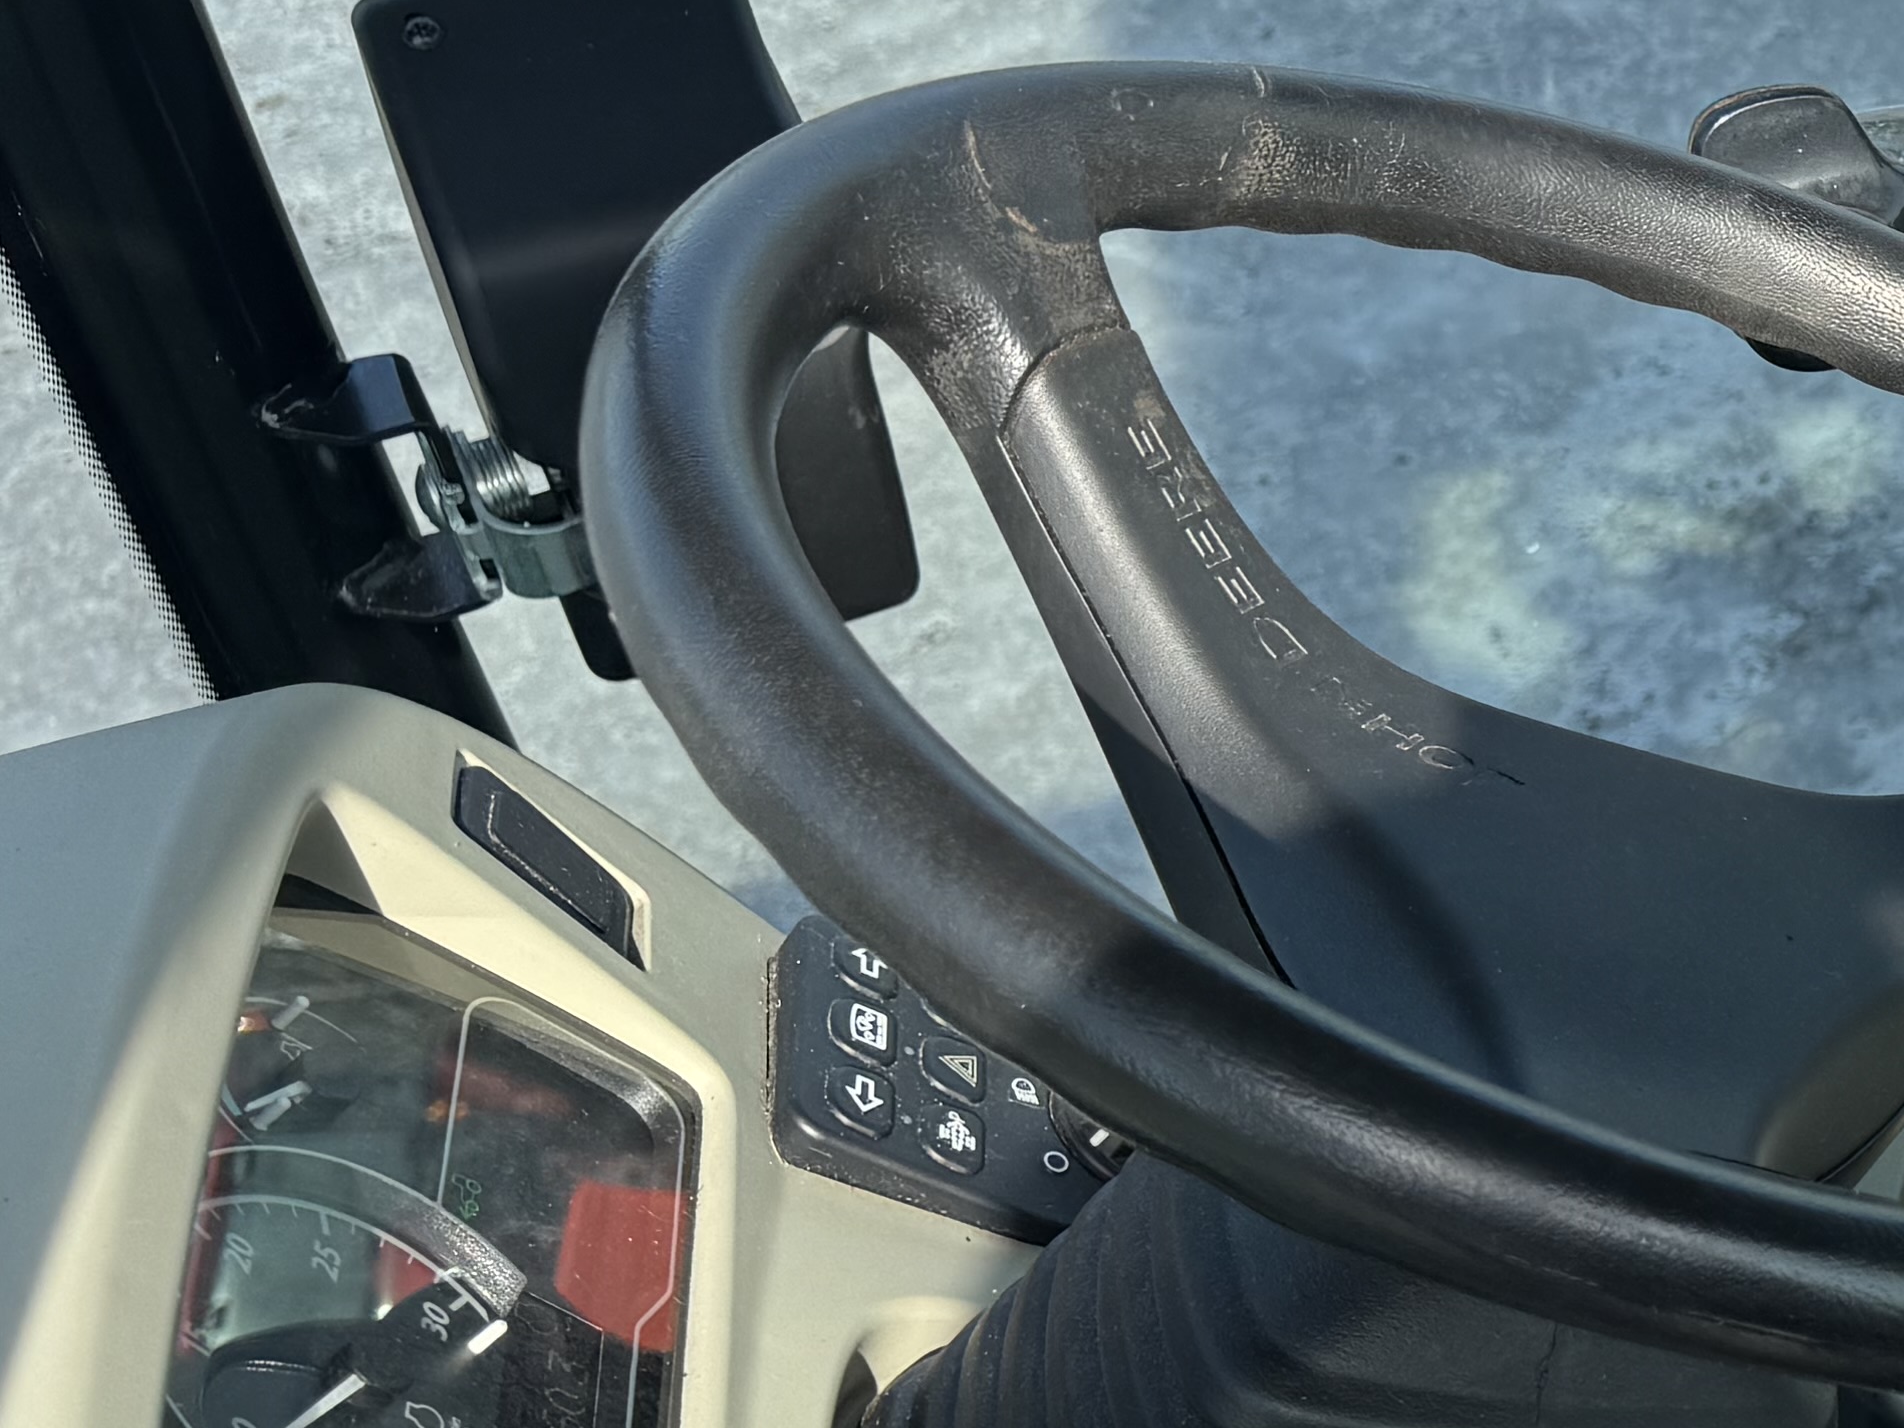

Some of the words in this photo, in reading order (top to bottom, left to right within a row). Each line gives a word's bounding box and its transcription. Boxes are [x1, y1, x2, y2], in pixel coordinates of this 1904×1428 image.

[1127, 418, 1308, 662] DEERE
[222, 1232, 255, 1274] 20
[310, 1239, 341, 1282] 25
[421, 1301, 450, 1341] 30
